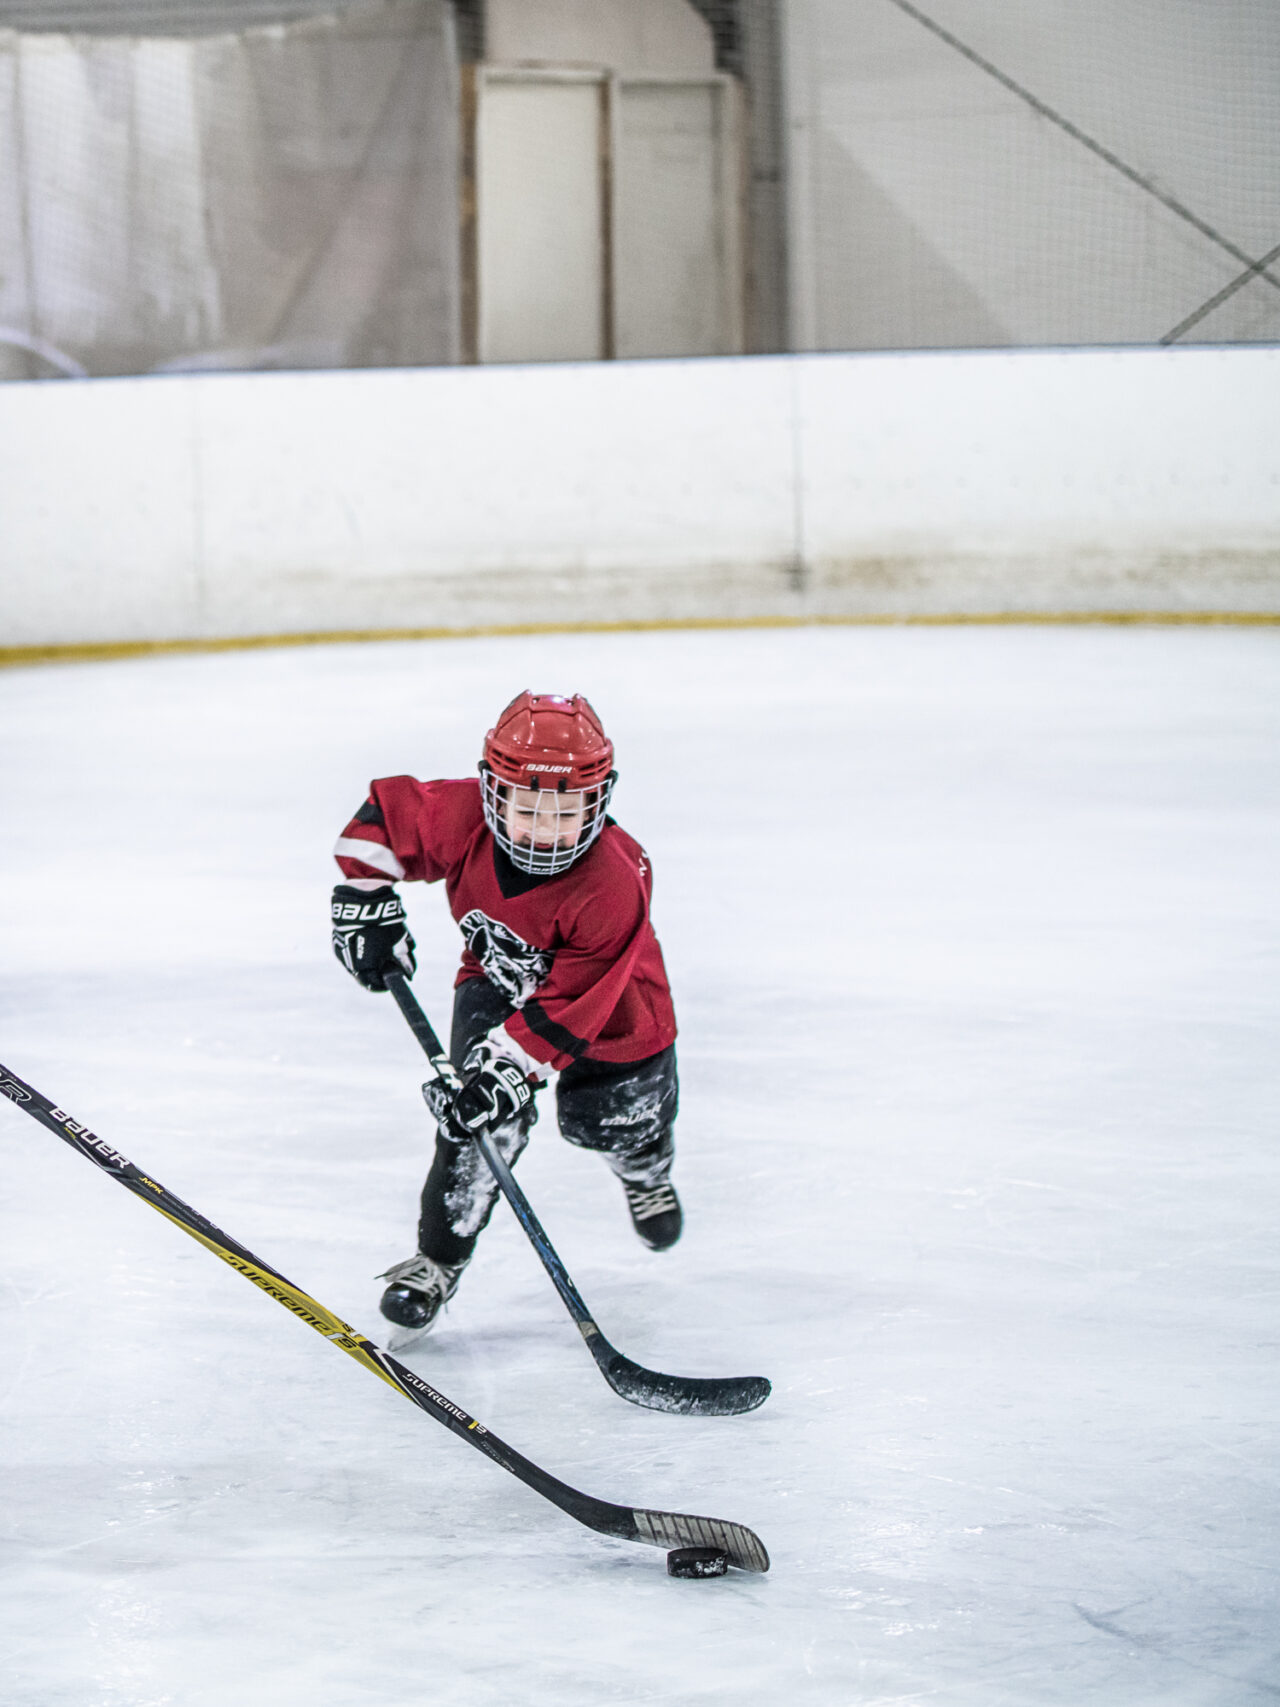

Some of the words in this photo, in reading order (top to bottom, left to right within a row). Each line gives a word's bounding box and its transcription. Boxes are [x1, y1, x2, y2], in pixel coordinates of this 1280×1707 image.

[526, 763, 573, 774] BAUER
[49, 1107, 131, 1169] BAUER
[222, 1254, 331, 1333] SUPREME
[402, 1372, 468, 1421] SUPREME
